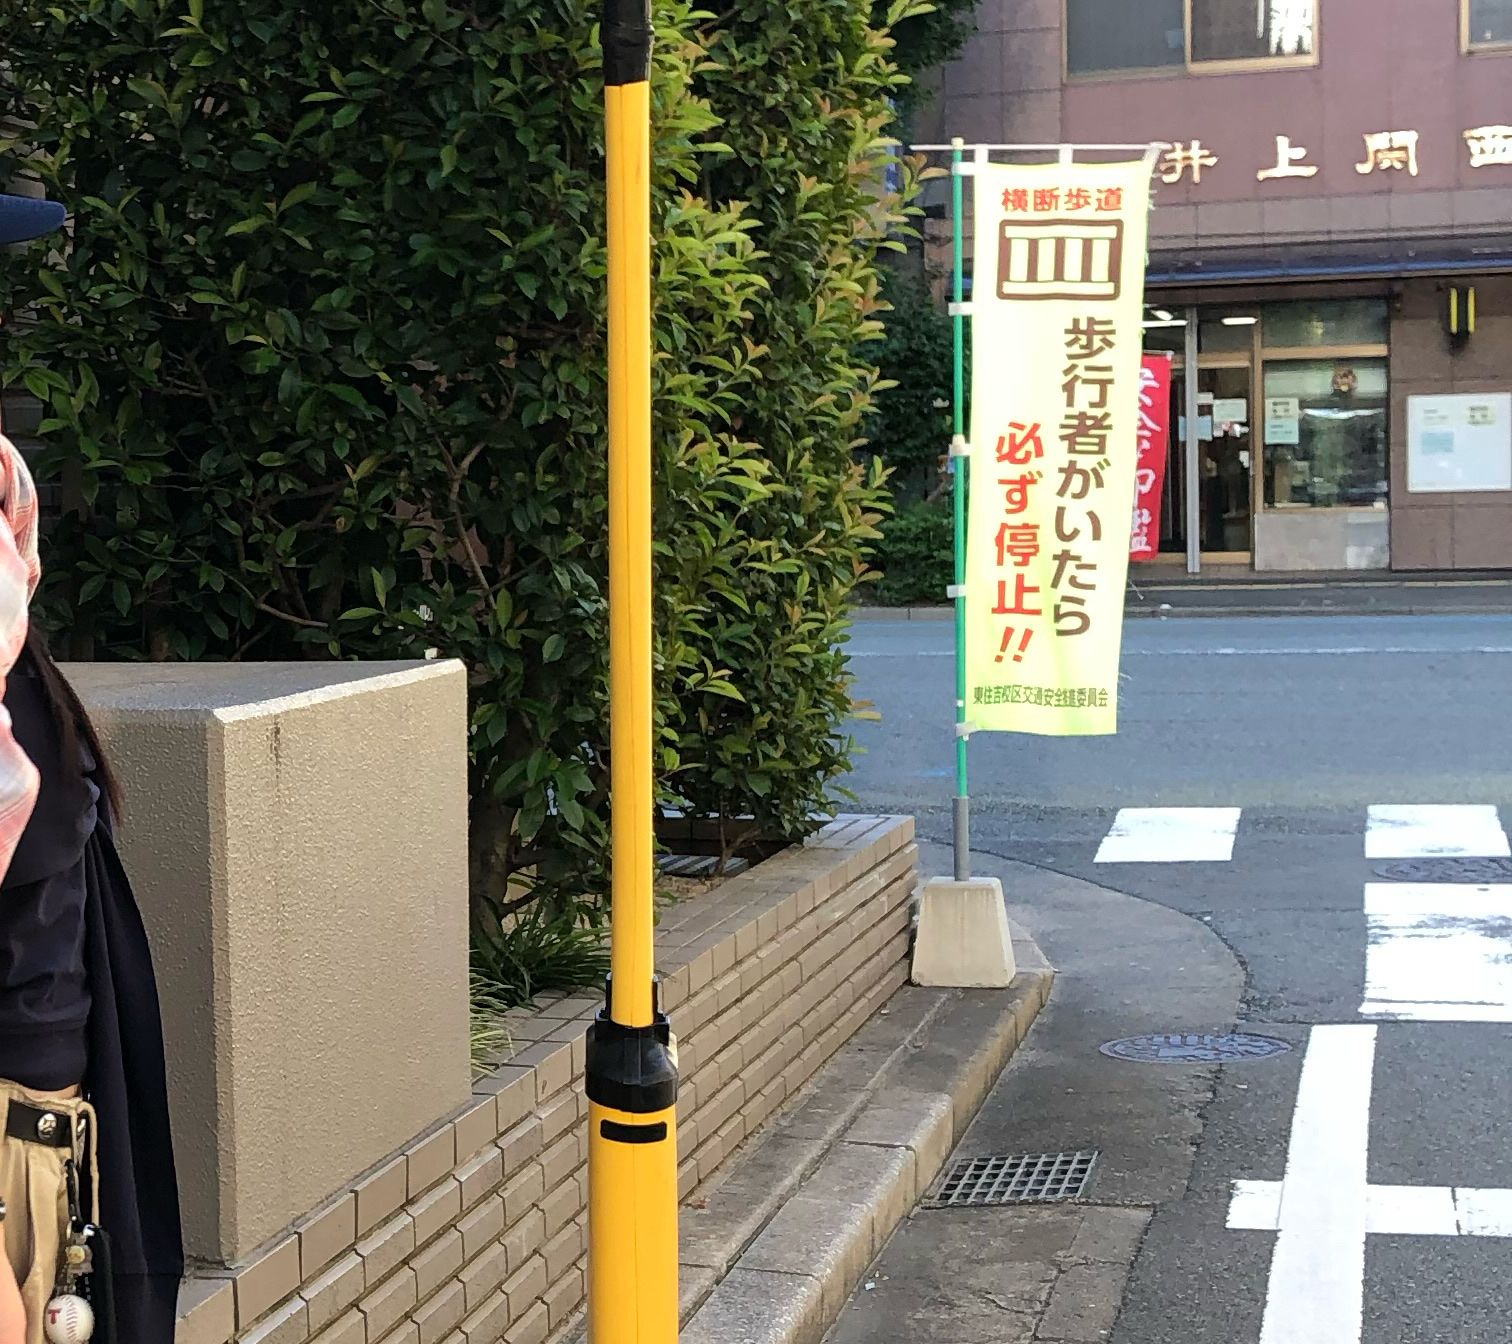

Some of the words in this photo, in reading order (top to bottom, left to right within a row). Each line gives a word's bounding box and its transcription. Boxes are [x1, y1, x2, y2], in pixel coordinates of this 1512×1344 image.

[1001, 186, 1124, 212] 横断歩道
[1050, 316, 1117, 637] 歩行者がいたら
